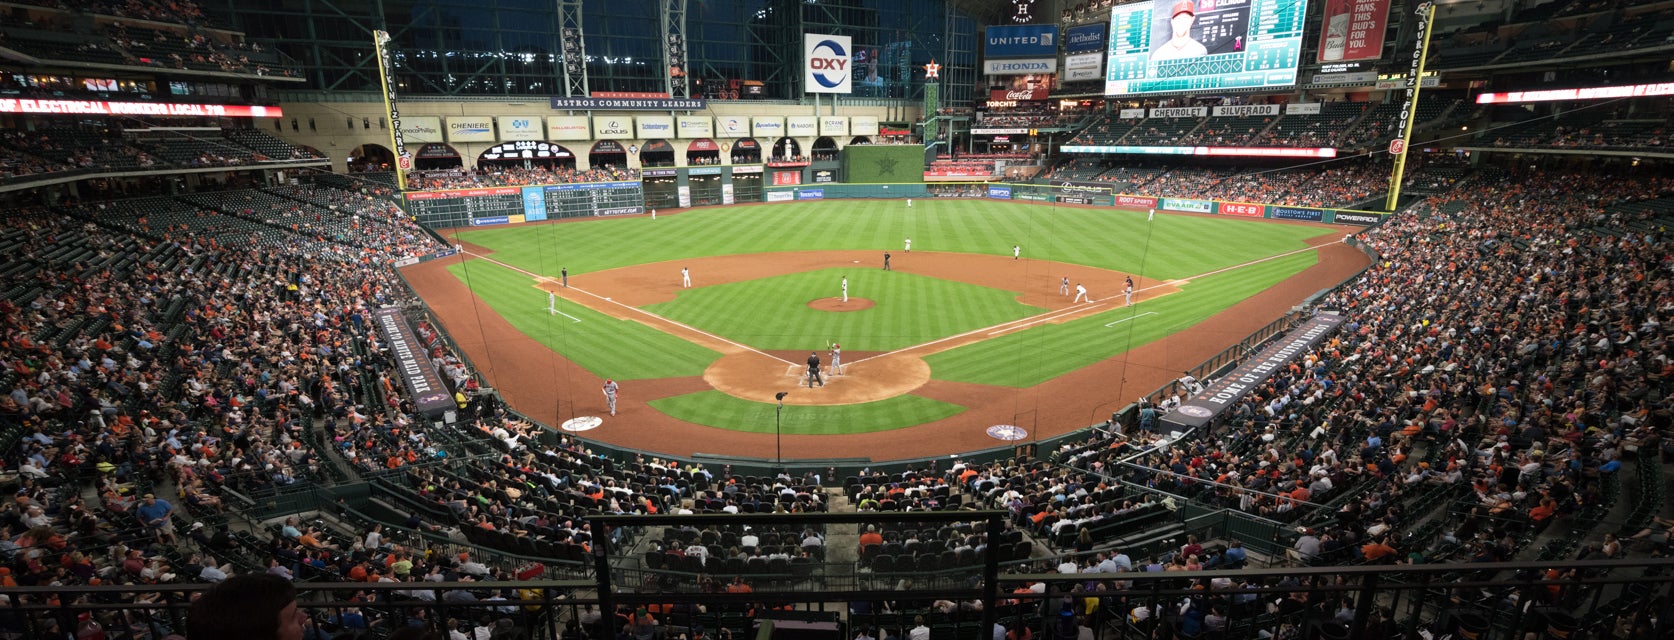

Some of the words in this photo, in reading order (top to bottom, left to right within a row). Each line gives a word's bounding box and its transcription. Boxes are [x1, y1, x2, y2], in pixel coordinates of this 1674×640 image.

[1354, 3, 1377, 12] FANS,
[1352, 21, 1376, 30] BUD'S
[990, 36, 1038, 46] UNITED
[1068, 32, 1100, 44] Methodist
[1350, 32, 1366, 40] FOR
[1349, 40, 1366, 48] YOU.
[810, 57, 847, 70] OXY
[1002, 62, 1049, 71] HONDA
[925, 64, 940, 78] H
[1006, 90, 1033, 100] Coca-Cola
[20, 100, 108, 114] ELECTRICAL
[168, 104, 204, 116] LOCAL
[1154, 108, 1202, 117] CHEVROLET
[1220, 106, 1272, 115] SILVERADO
[1398, 101, 1412, 138] FOUL
[1336, 214, 1378, 222] POWERADE
[393, 340, 414, 360] MINUTE
[402, 359, 422, 375] MAID
[1208, 384, 1243, 404] HOME
[1240, 373, 1260, 384] OF
[1254, 362, 1276, 374] THE
[1269, 338, 1308, 362] HOUSTON
[410, 375, 431, 393] PARK
